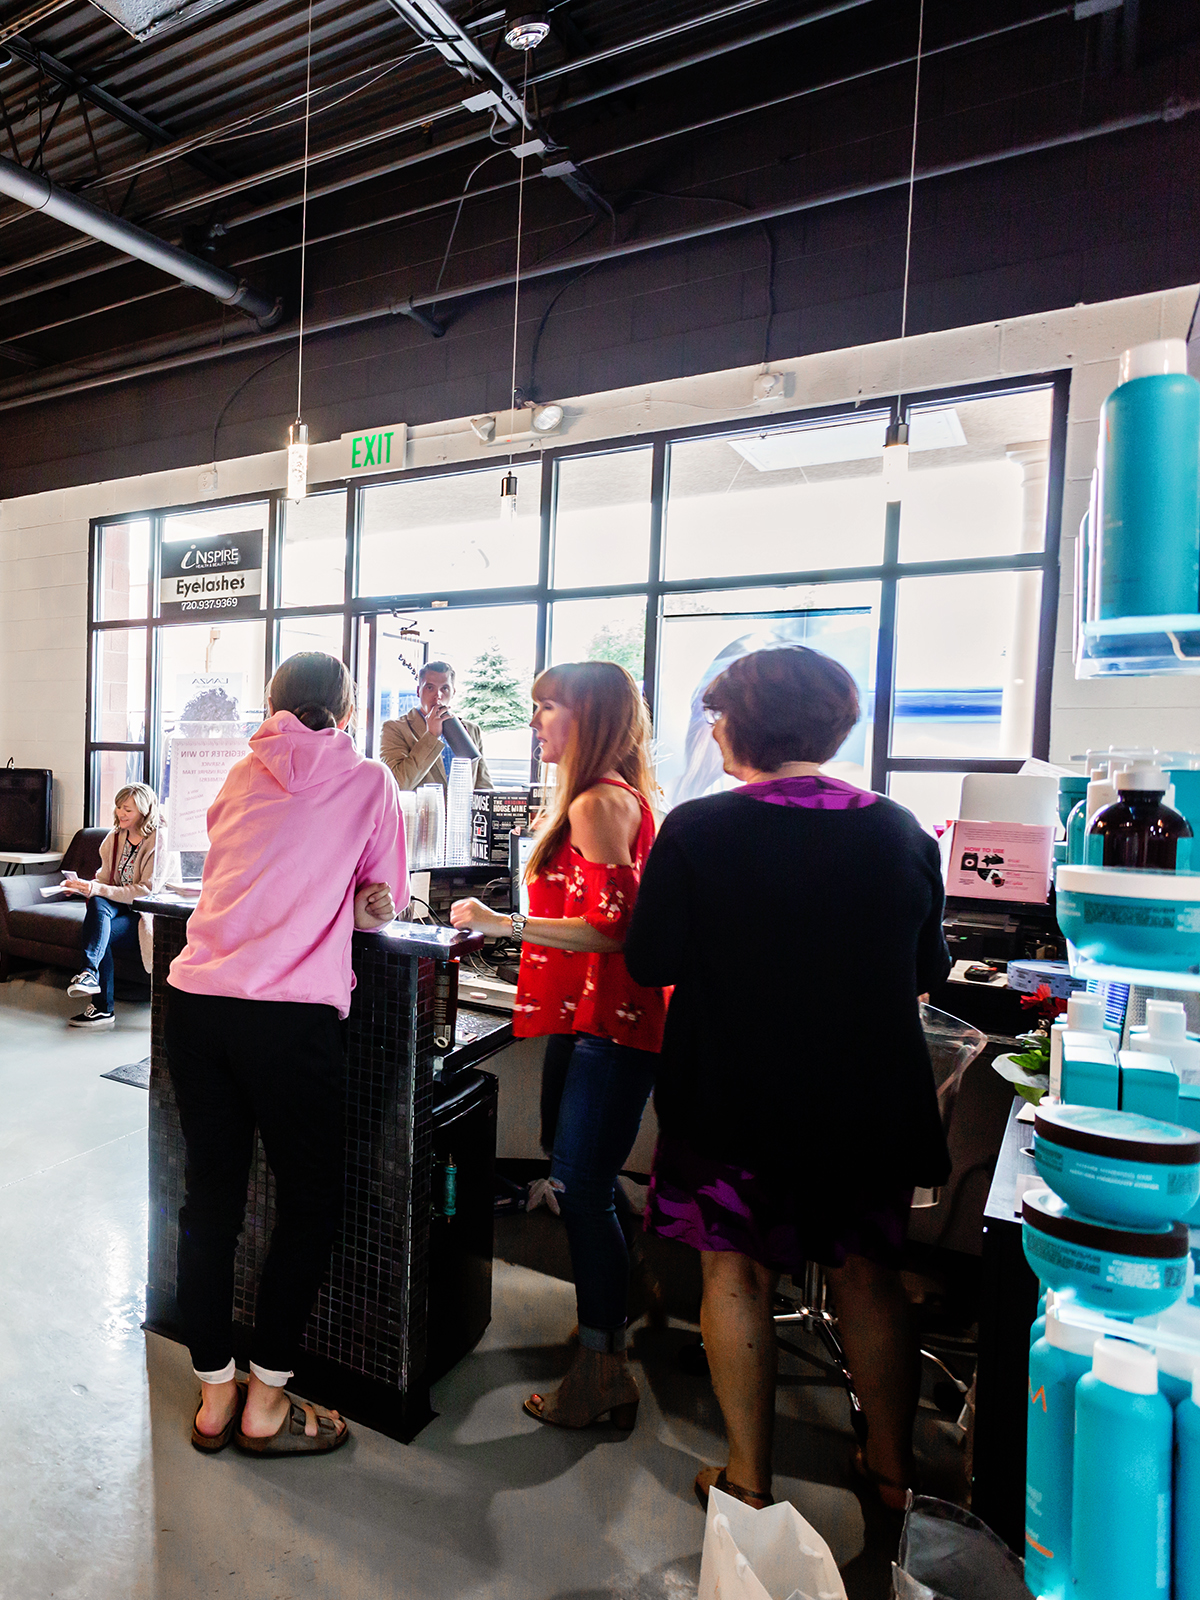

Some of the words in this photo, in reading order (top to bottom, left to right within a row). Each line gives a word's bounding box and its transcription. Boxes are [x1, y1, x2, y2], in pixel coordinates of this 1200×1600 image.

[352, 432, 394, 469] EXIT
[176, 575, 245, 597] Eyelashes
[181, 598, 238, 611] 720.937.9369
[472, 794, 490, 812] HOUSE
[493, 805, 511, 813] HOUSE
[511, 805, 527, 813] WINE
[472, 843, 489, 860] WINE
